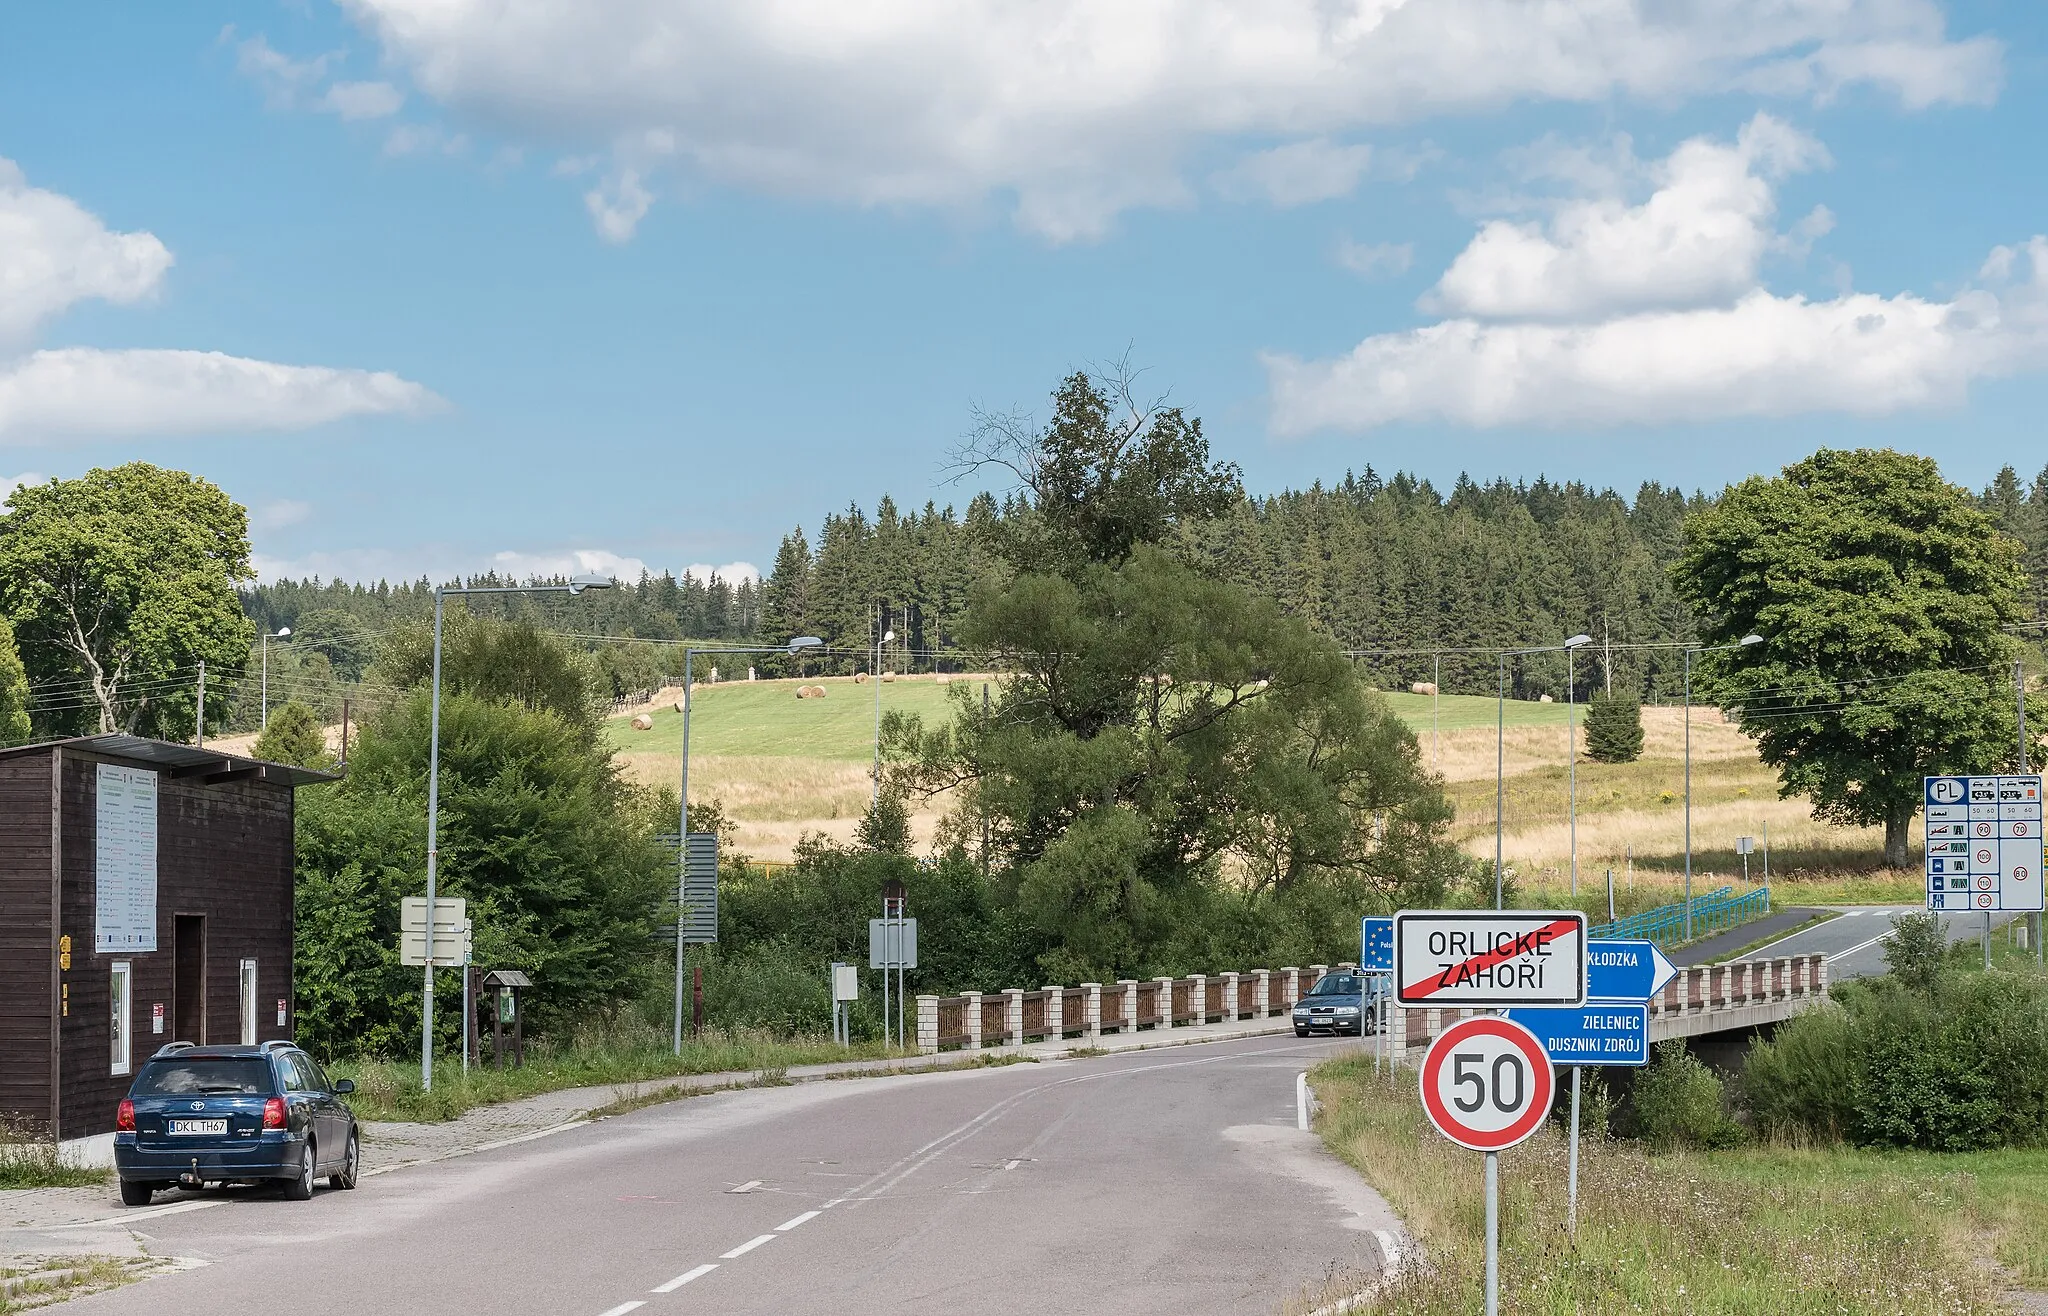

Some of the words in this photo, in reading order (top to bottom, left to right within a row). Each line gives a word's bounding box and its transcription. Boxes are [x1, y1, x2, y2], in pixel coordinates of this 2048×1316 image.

[1937, 783, 1958, 798] PL
[1428, 925, 1553, 957] ORLICKÉ
[1587, 951, 1639, 967] KŁODZKA
[1437, 957, 1544, 989] ZÁHOŘÍ
[1582, 1015, 1640, 1031] ZIELENIEC
[1548, 1037, 1601, 1052] DUSZNIKI
[1604, 1034, 1640, 1053] ZDRÓJ
[1453, 1053, 1524, 1113] 50
[176, 1122, 197, 1132] DKL
[201, 1121, 225, 1132] TH67
